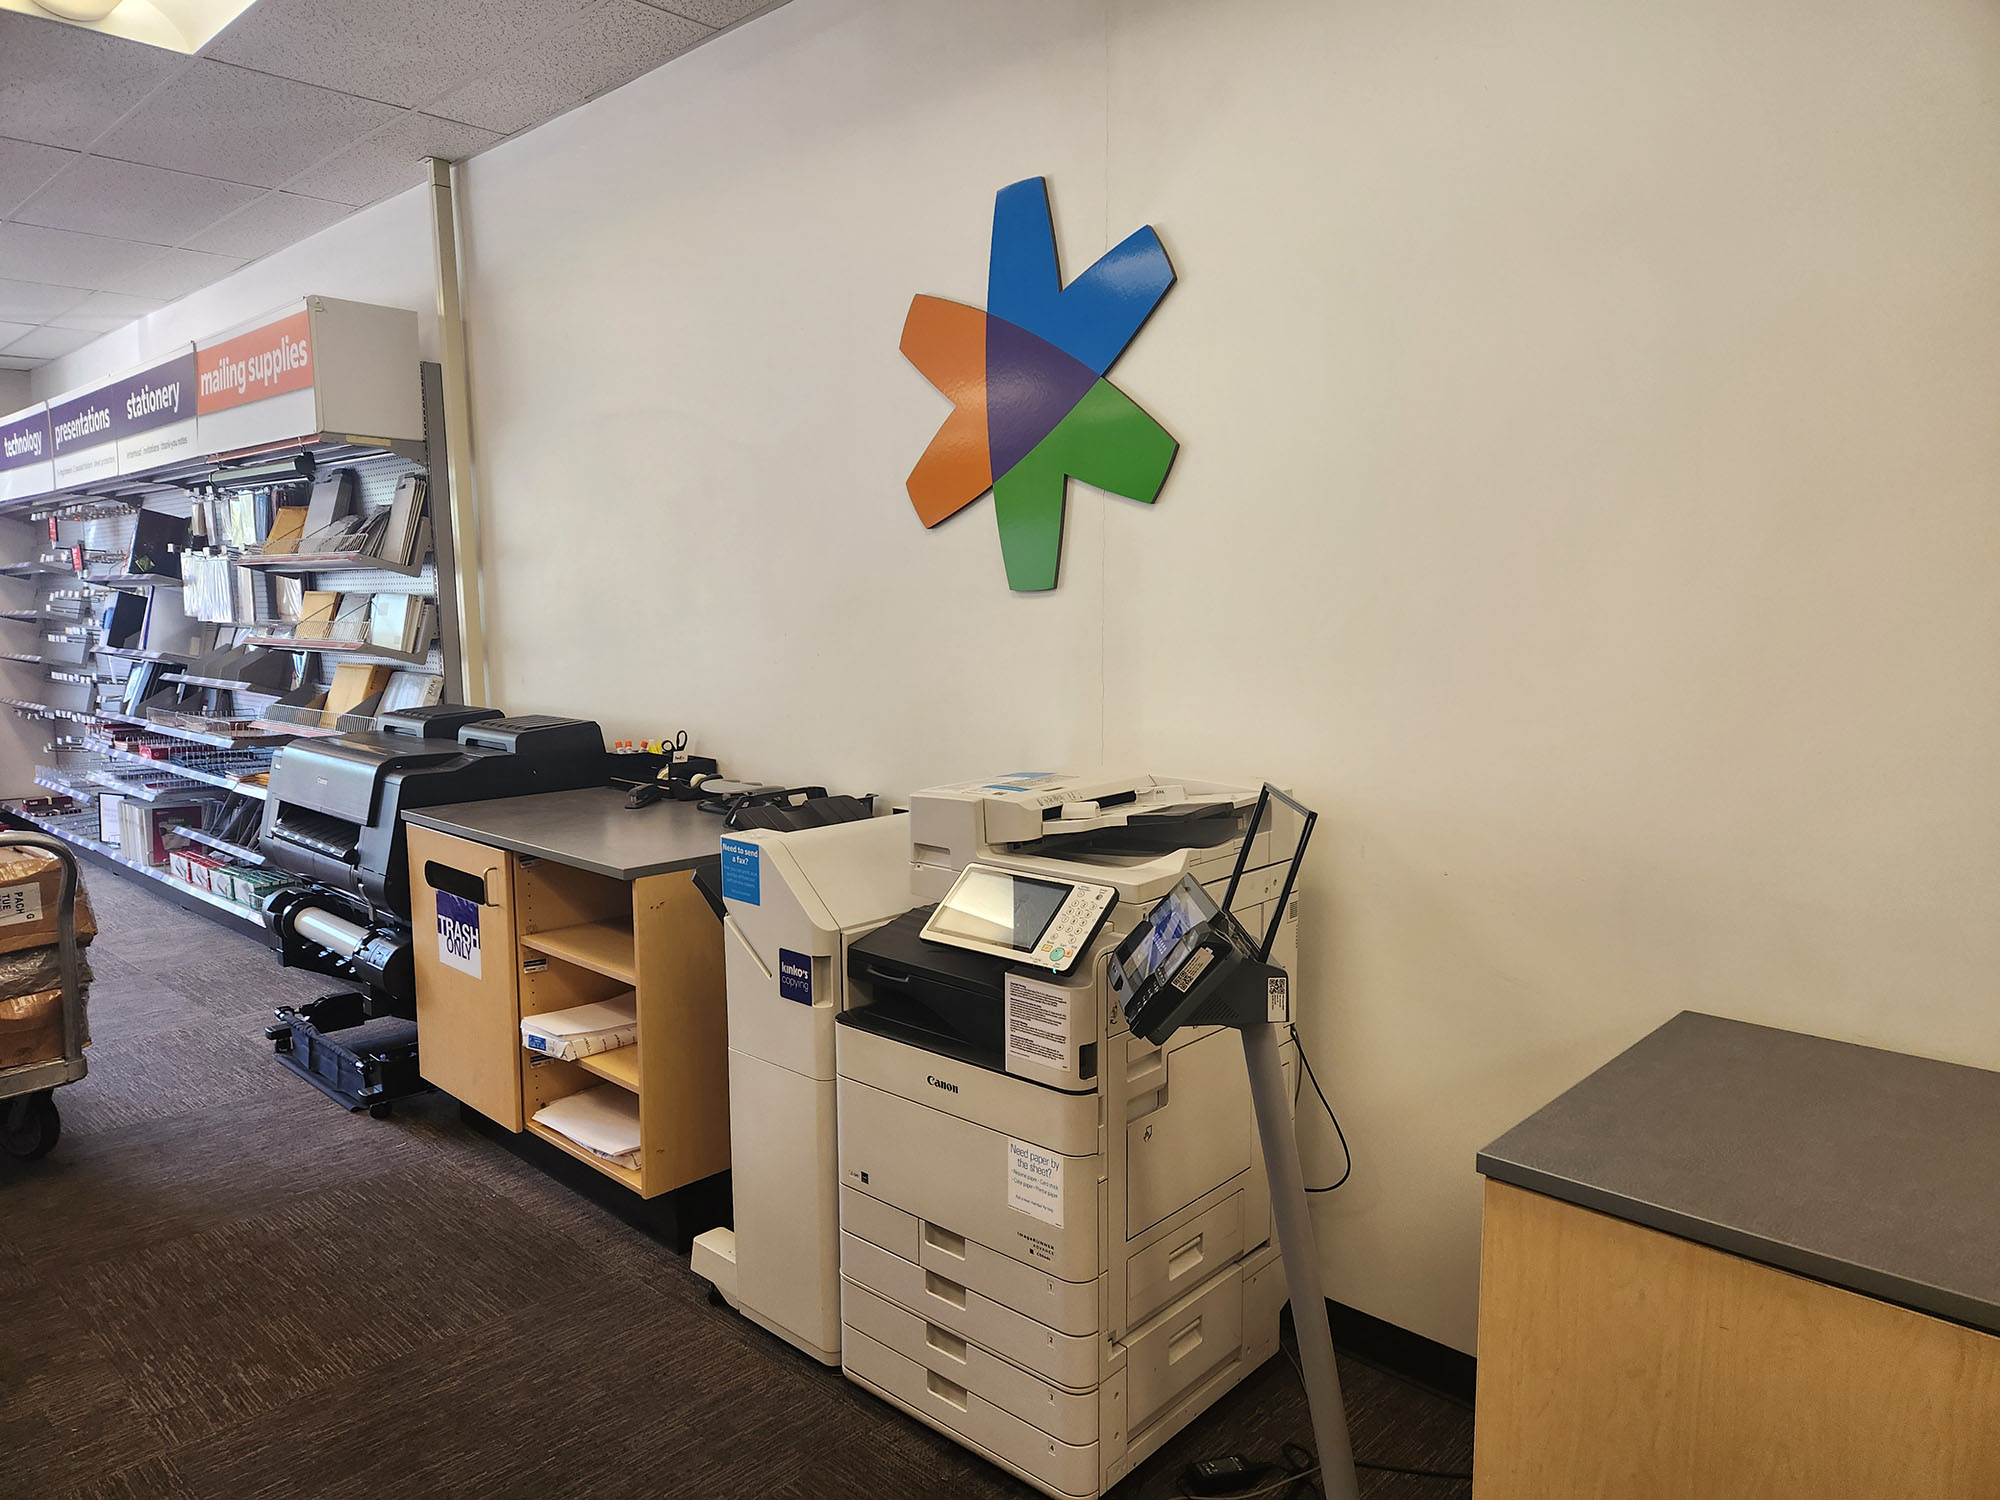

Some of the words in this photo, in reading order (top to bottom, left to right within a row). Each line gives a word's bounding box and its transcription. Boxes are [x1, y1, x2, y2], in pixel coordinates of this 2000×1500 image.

[200, 356, 246, 396] mailing
[248, 337, 308, 386] supplies
[126, 381, 180, 420] stationery
[54, 406, 111, 450] presentations
[3, 429, 42, 457] technology
[722, 843, 737, 854] Need
[737, 846, 744, 855] to
[744, 849, 759, 858] send
[736, 855, 749, 865] fax?
[2, 893, 11, 911] TUE
[14, 892, 25, 914] PACH
[438, 914, 480, 949] TRASH
[446, 936, 472, 960] ONLY
[781, 961, 809, 980] kinko's
[781, 975, 809, 993] copying
[926, 1075, 959, 1094] Canon
[1010, 1143, 1029, 1159] Need
[1029, 1152, 1050, 1166] paper
[1051, 1157, 1060, 1171] by
[1017, 1158, 1029, 1170] the
[1029, 1162, 1052, 1178] sheet?
